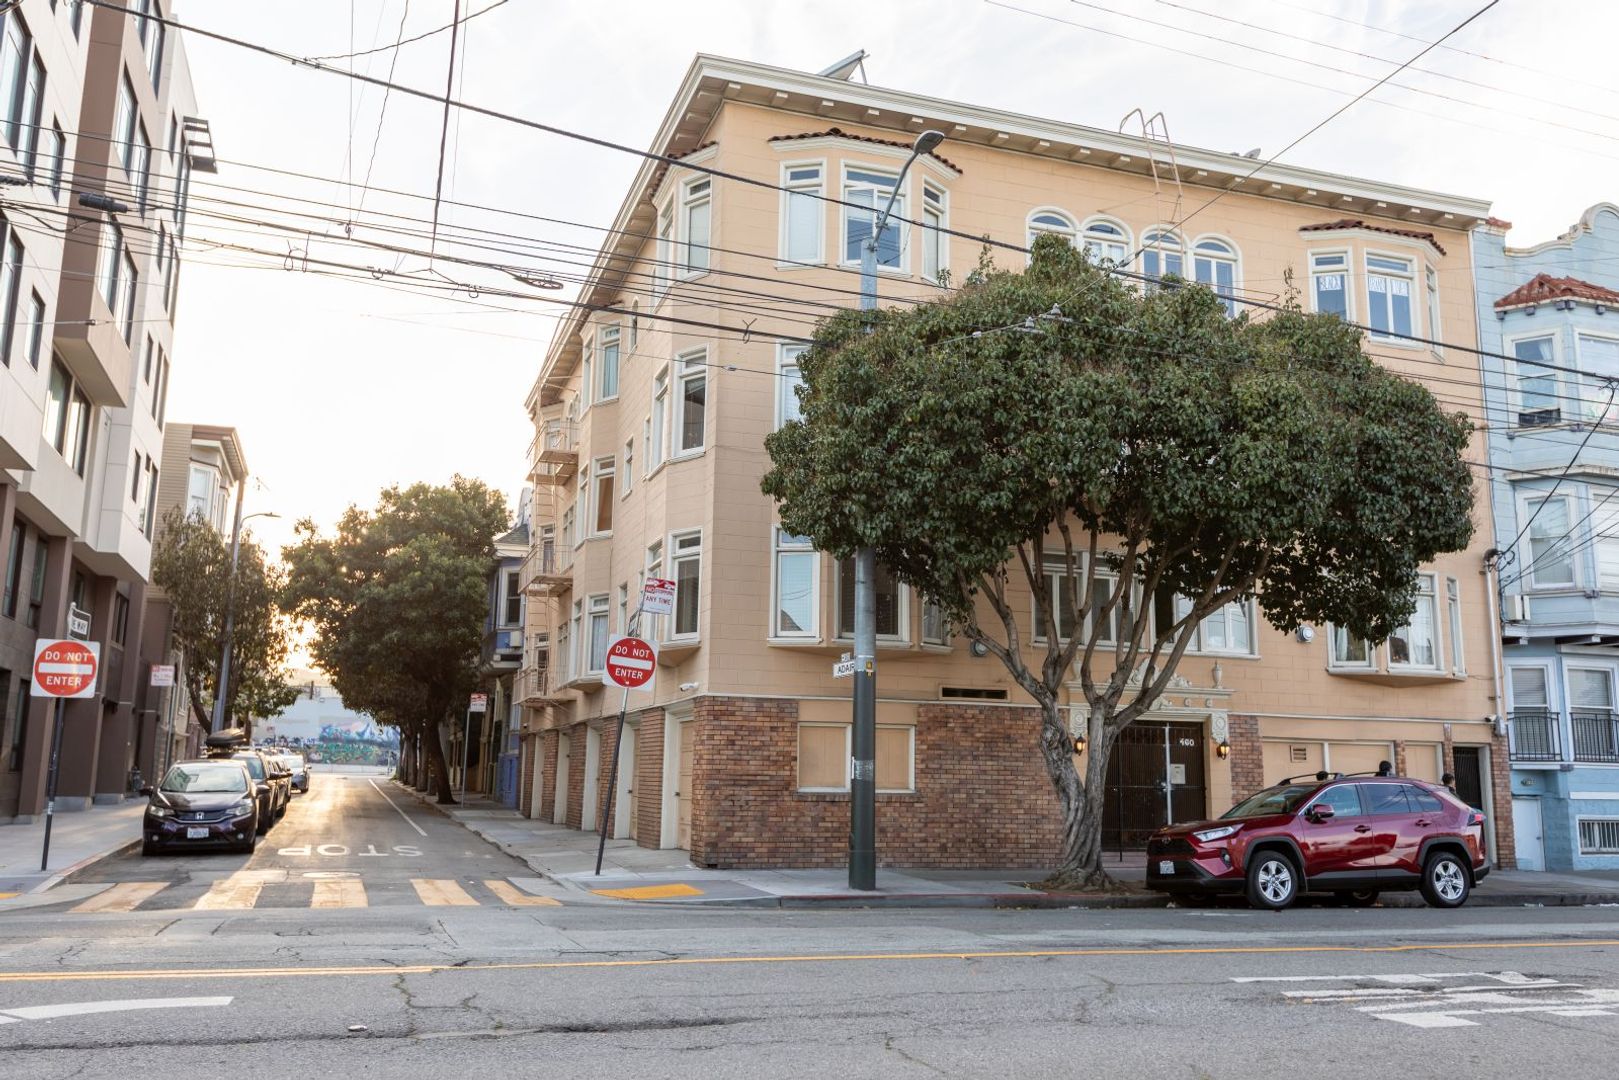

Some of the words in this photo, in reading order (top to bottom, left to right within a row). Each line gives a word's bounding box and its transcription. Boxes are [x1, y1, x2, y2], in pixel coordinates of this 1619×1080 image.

[45, 651, 61, 661] DO
[66, 652, 90, 662] NOT
[616, 645, 628, 655] DO
[633, 648, 650, 658] NOT
[615, 668, 643, 680] ENTER
[46, 676, 82, 687] ENTER
[277, 844, 424, 857] STOP
